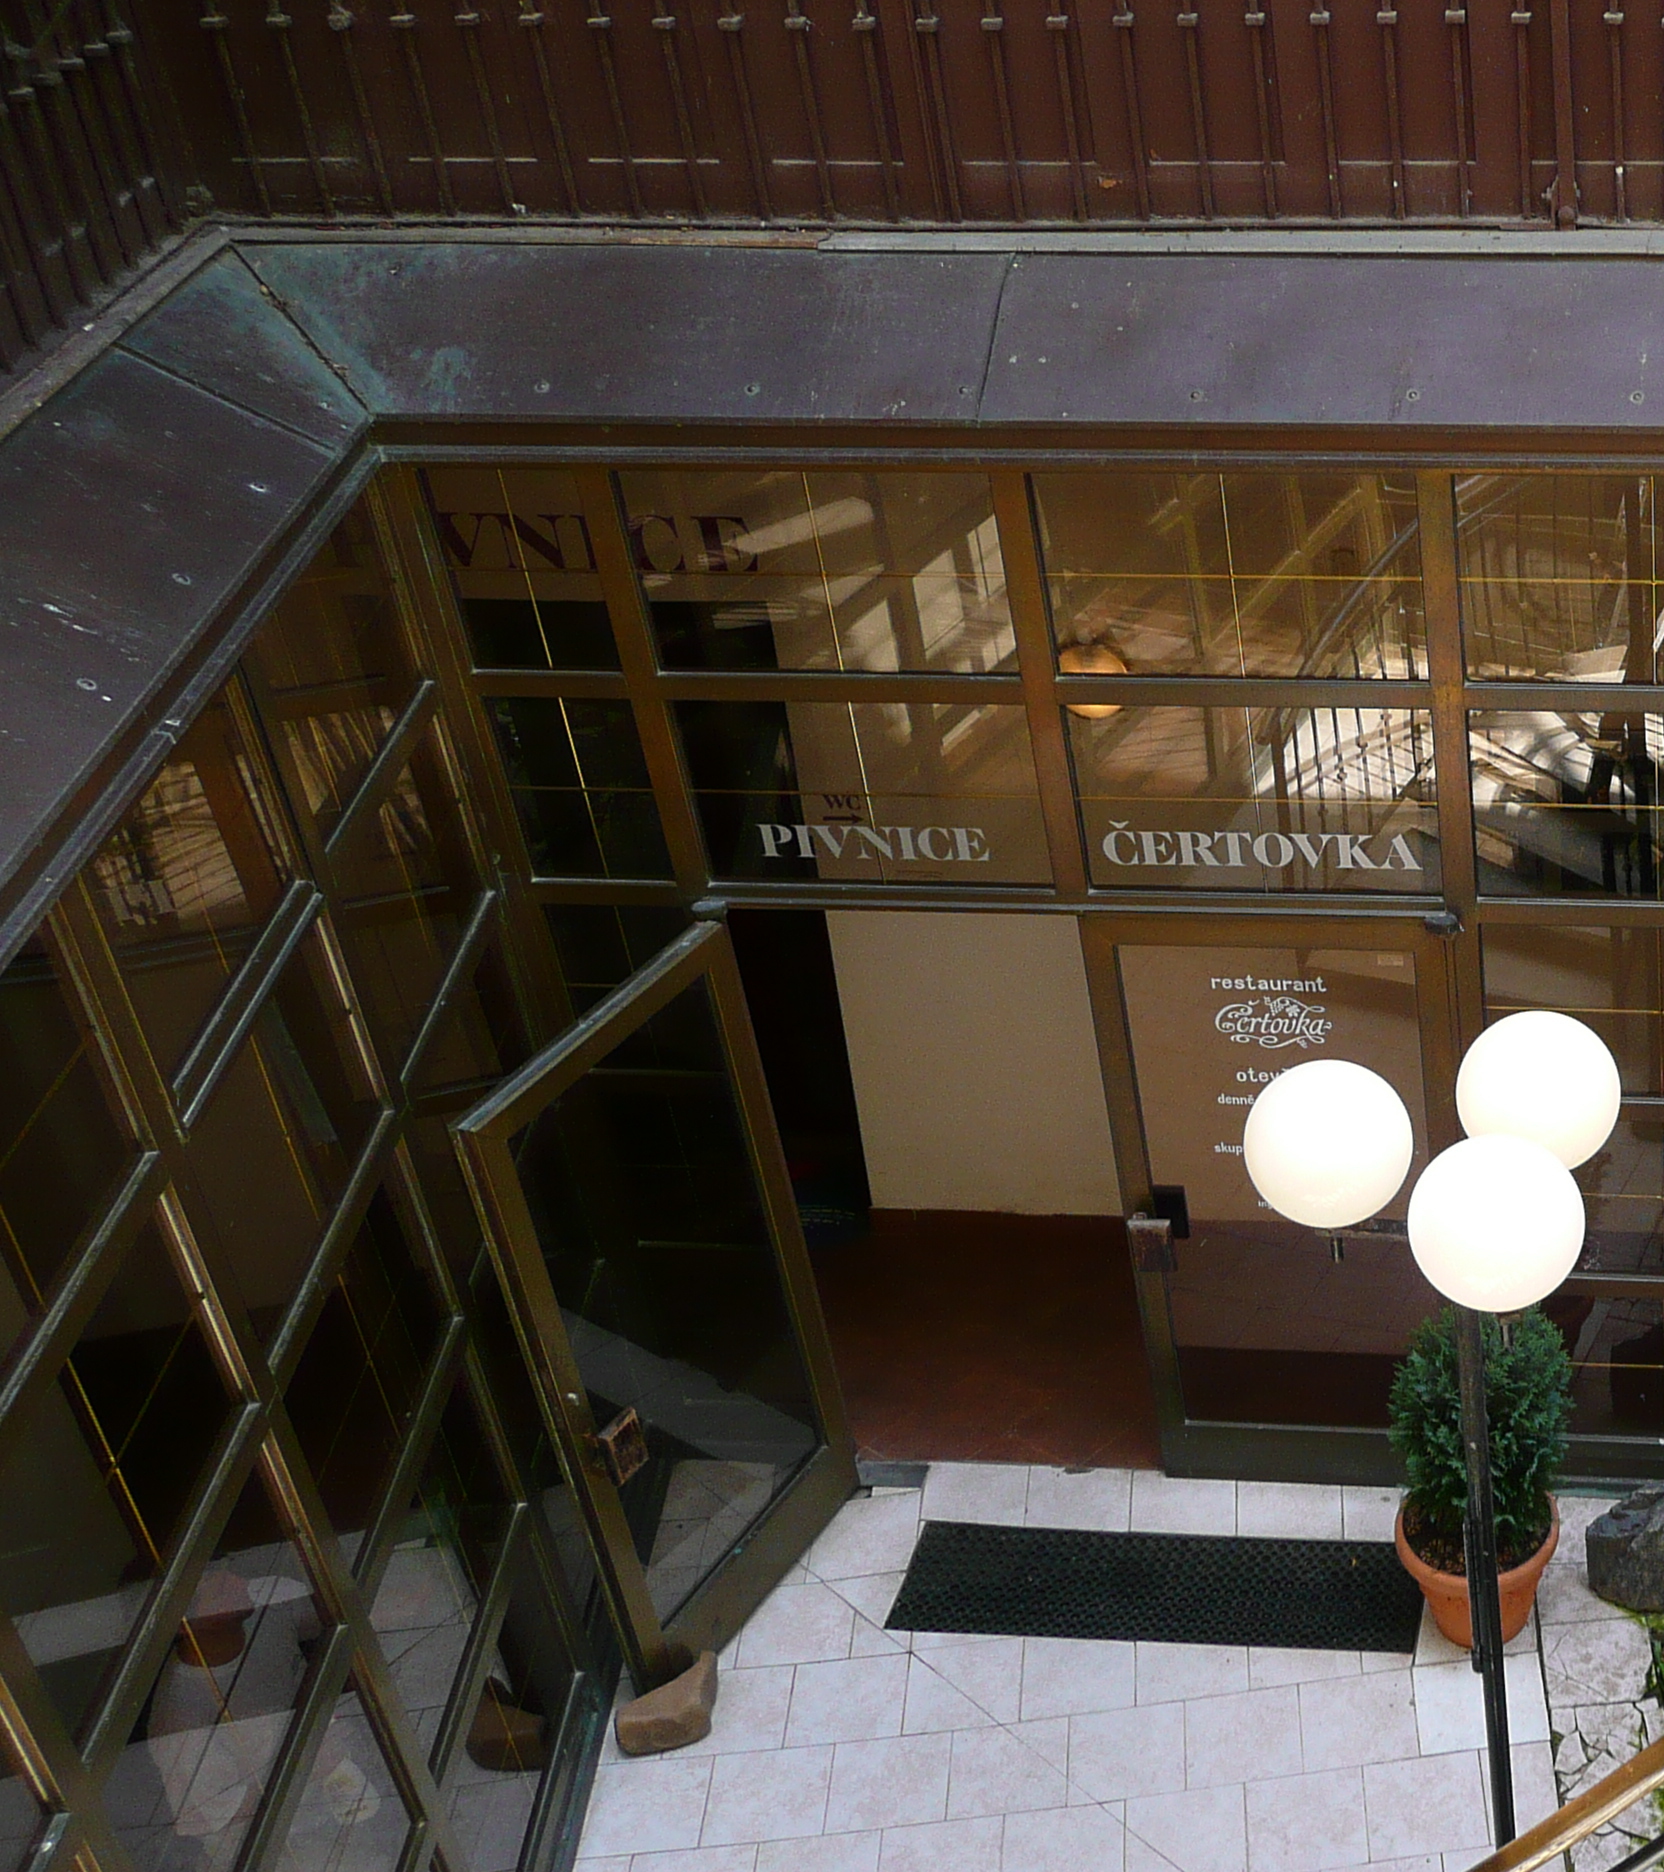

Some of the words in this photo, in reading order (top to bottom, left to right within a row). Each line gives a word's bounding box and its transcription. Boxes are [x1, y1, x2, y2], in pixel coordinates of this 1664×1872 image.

[822, 793, 862, 811] WC
[755, 823, 991, 862] PIVNICE
[1102, 820, 1423, 871] ČERTOVKA
[1210, 974, 1327, 993] restaurant
[1215, 998, 1333, 1044] Čertovka
[1236, 1067, 1290, 1083] otev
